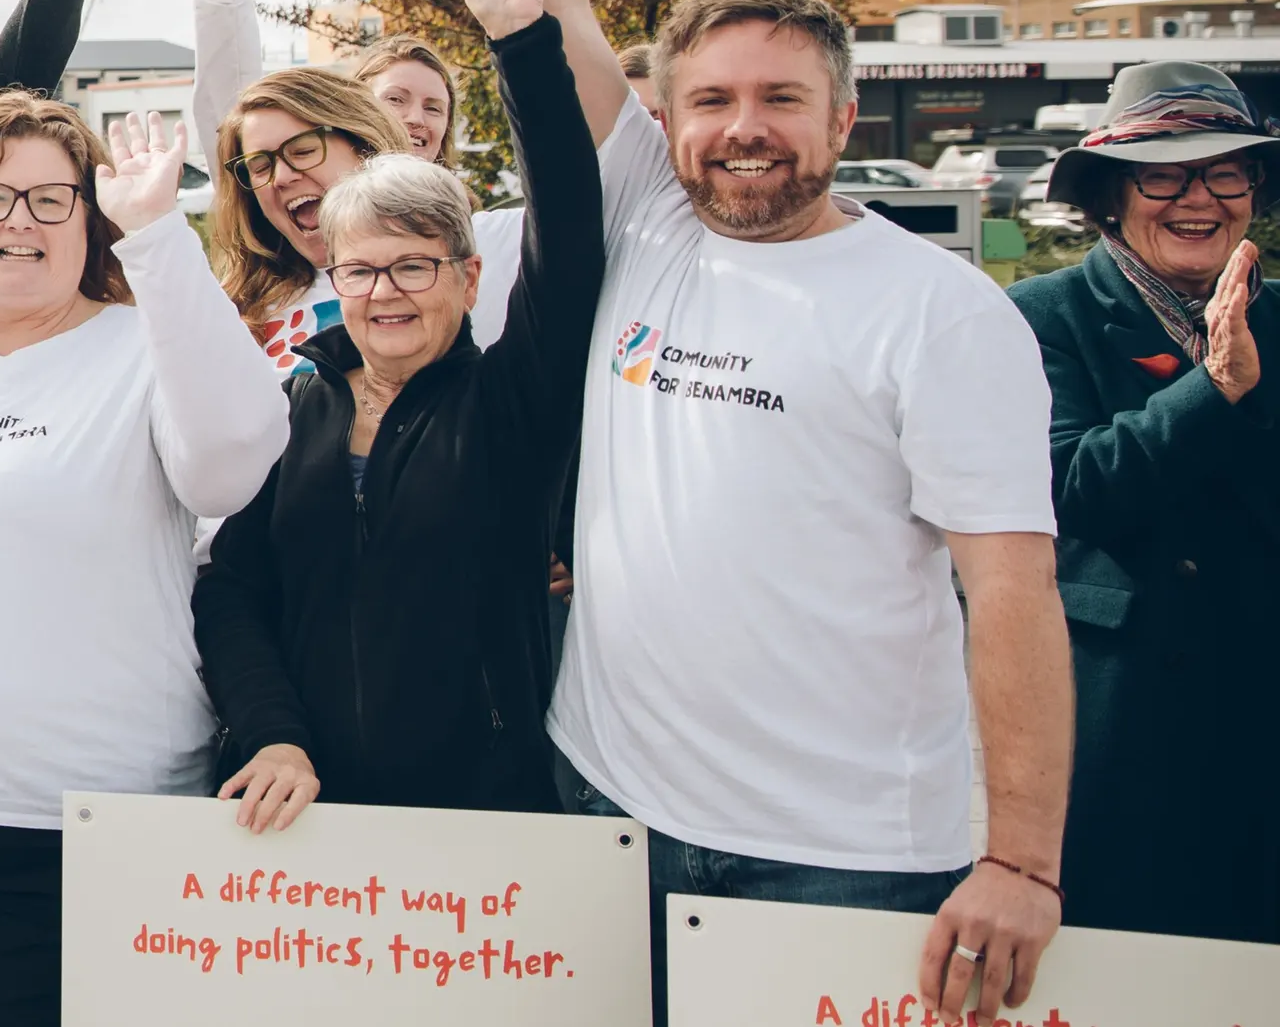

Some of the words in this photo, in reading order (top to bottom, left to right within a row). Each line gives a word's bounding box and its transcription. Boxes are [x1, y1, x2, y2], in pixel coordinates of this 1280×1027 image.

[999, 64, 1027, 78] BAR
[649, 370, 680, 395] FOR
[686, 381, 785, 413] BENAMBRA
[182, 872, 204, 900] A
[220, 868, 386, 916] different
[402, 888, 467, 934] way
[481, 881, 522, 917] of
[133, 923, 222, 973] doing
[236, 926, 374, 975] politics,
[388, 933, 575, 987] together.
[815, 994, 842, 1026] A
